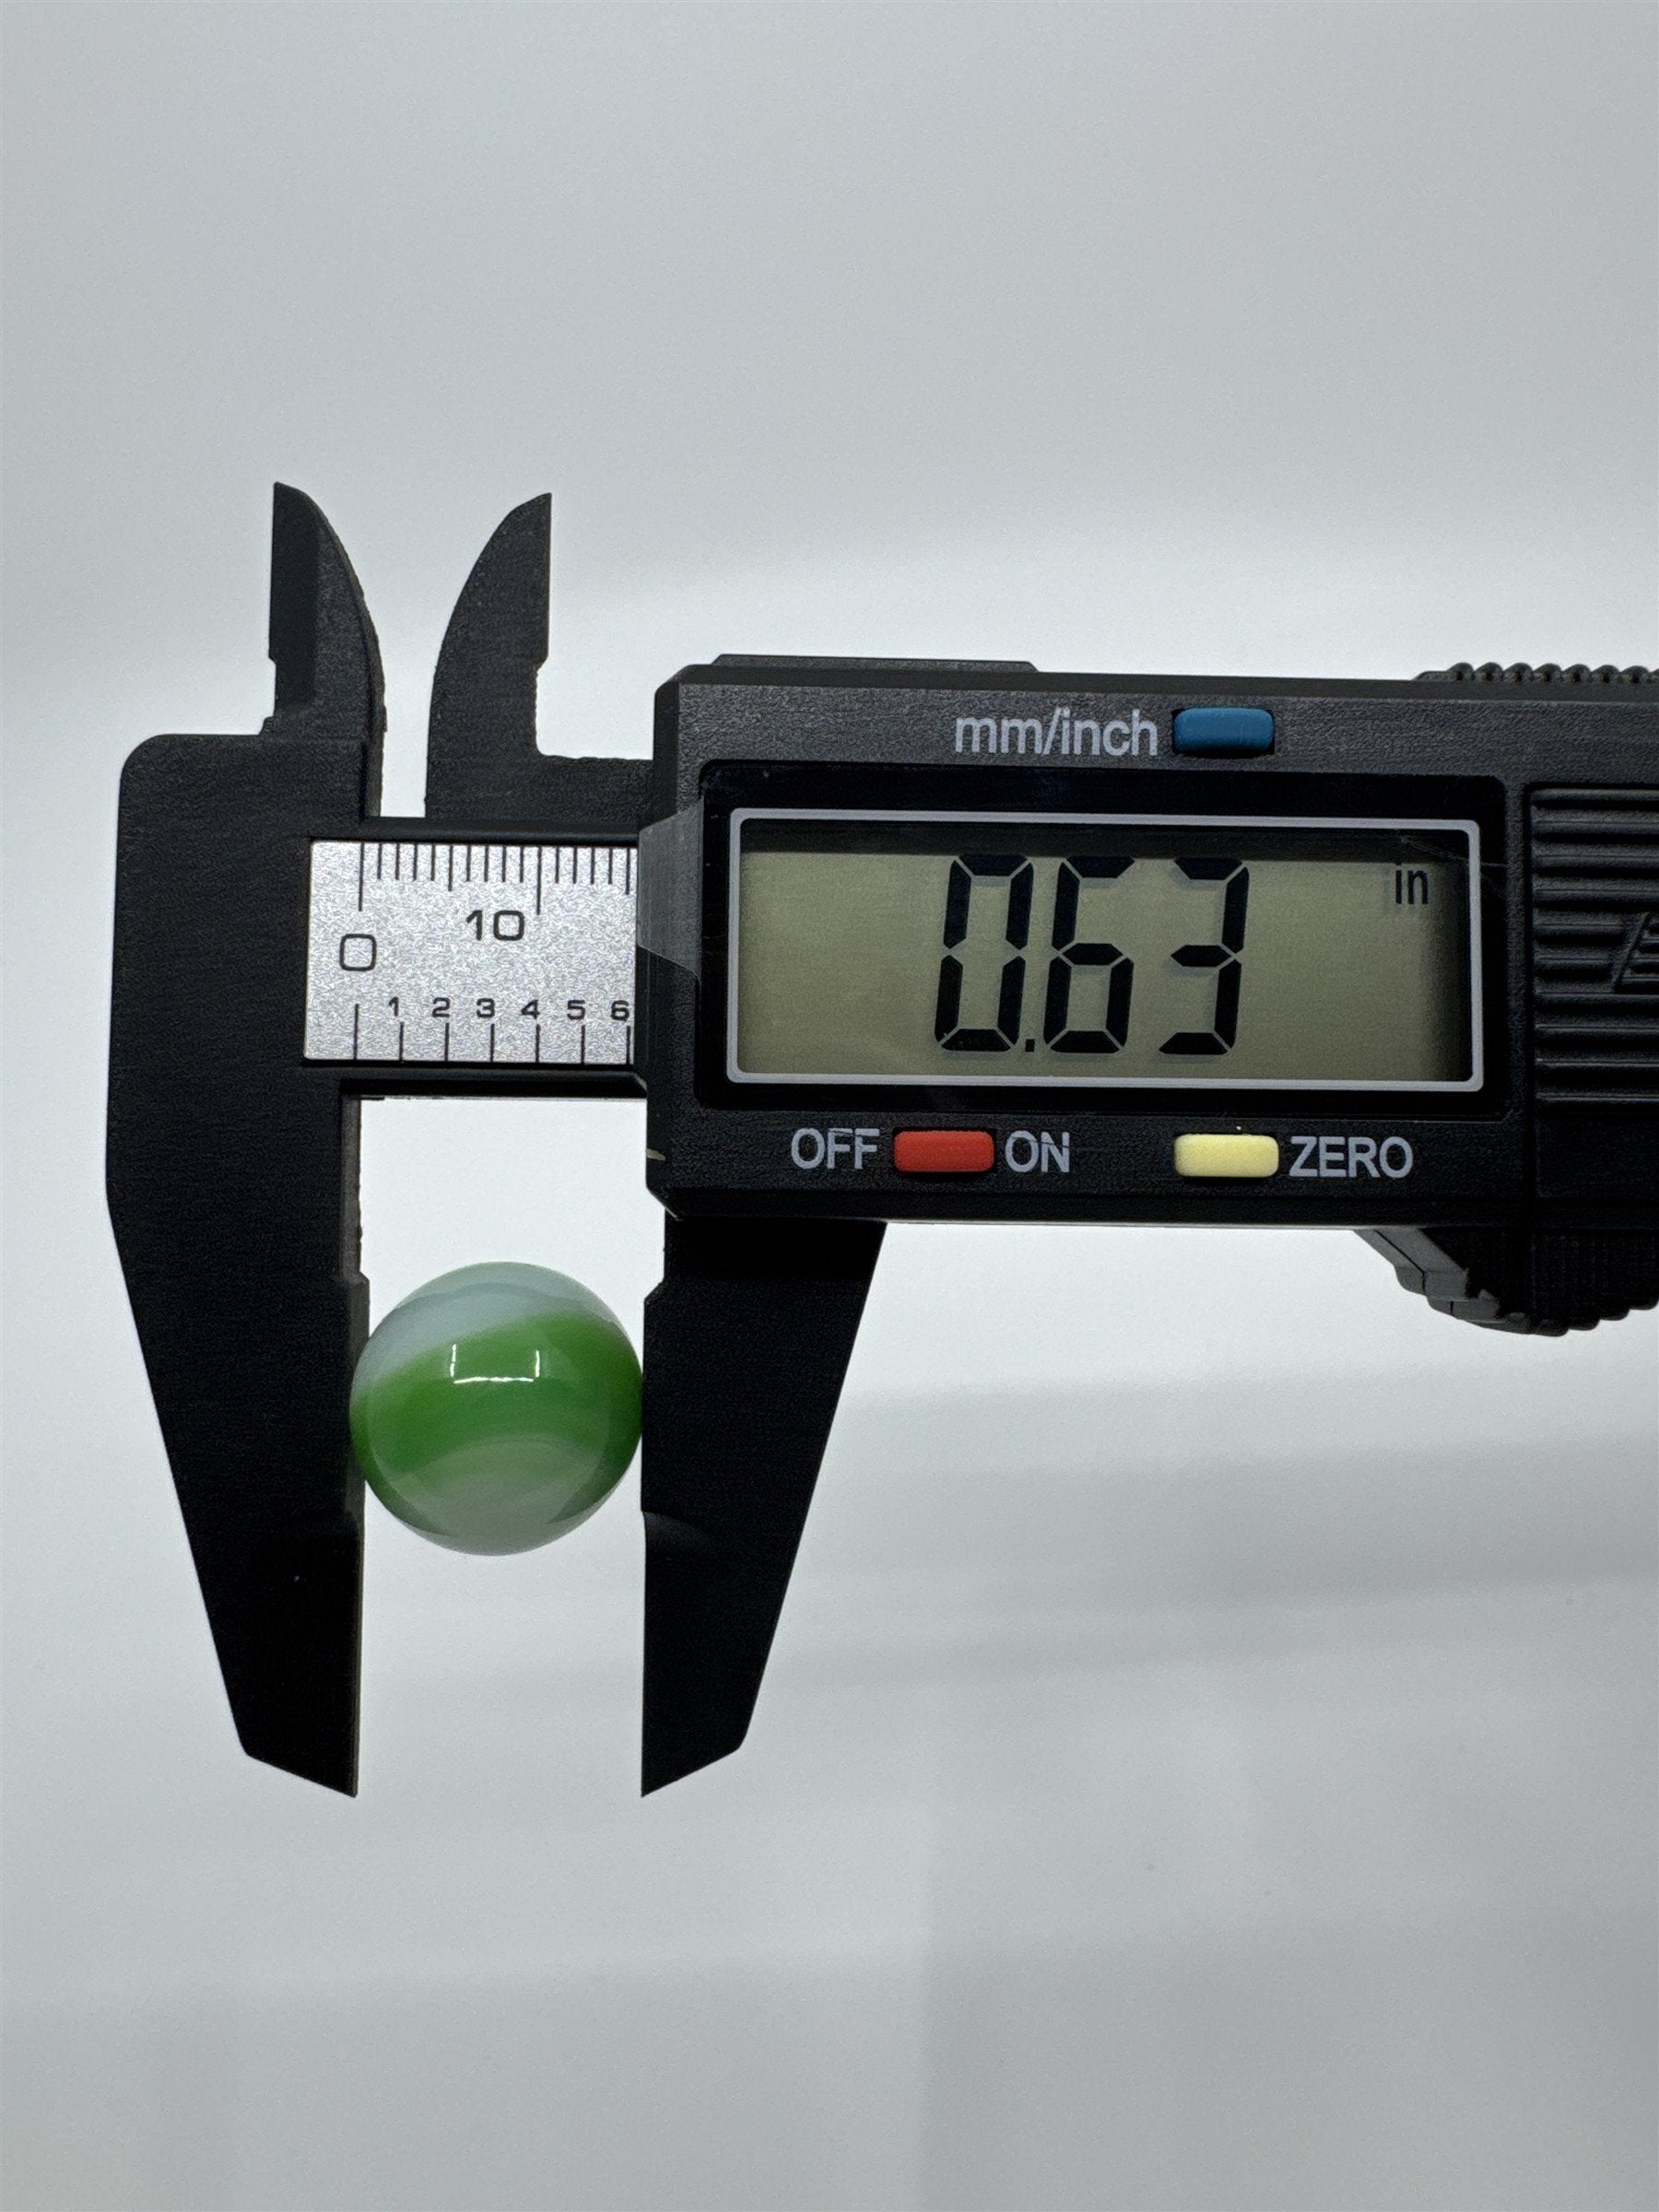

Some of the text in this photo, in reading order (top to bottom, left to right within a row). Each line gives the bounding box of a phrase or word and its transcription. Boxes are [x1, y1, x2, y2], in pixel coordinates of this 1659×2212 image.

[953, 707, 1159, 758] mm/inch
[1394, 862, 1430, 906] in
[465, 909, 525, 942] 10
[339, 934, 377, 972] 0
[933, 853, 1251, 1056] 0.63
[388, 995, 630, 1021] 1 2 3 4 5 6
[790, 1126, 880, 1172] OFF
[1005, 1129, 1072, 1174] ON
[1289, 1135, 1414, 1181] ZERO
